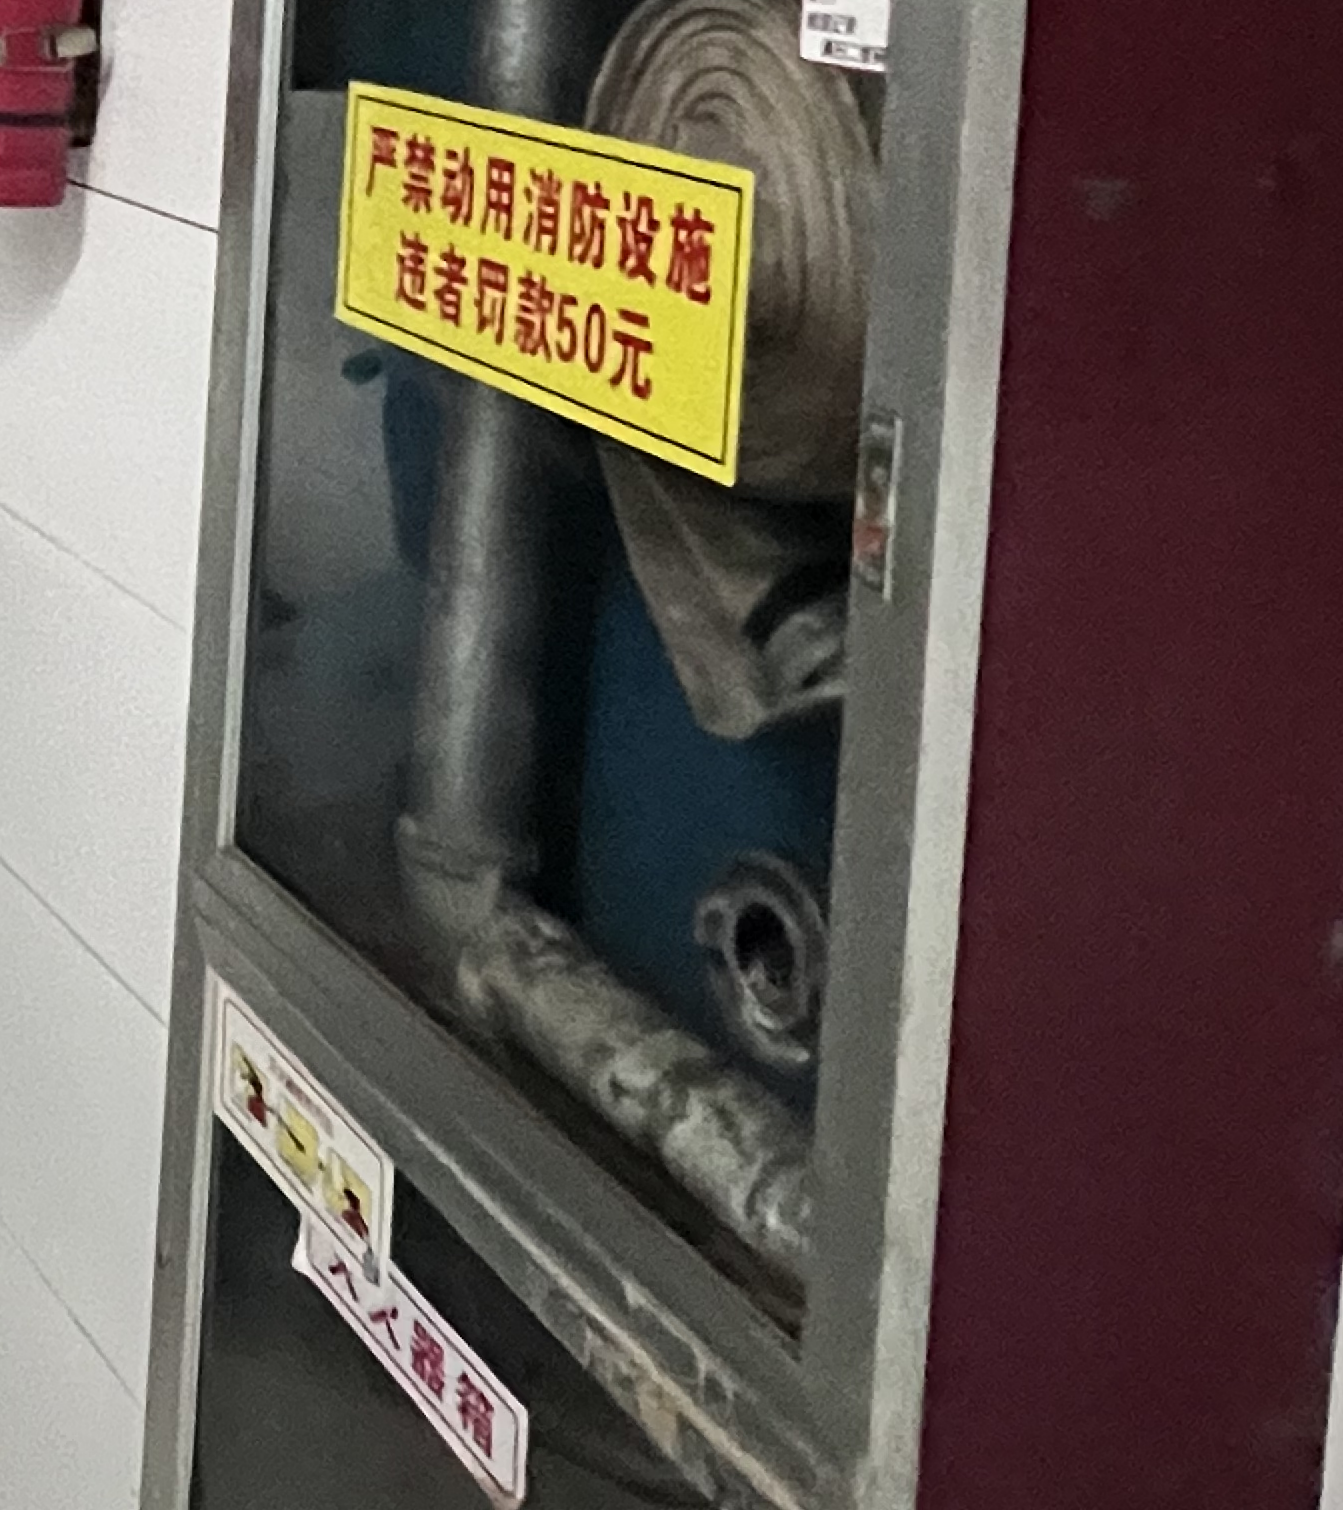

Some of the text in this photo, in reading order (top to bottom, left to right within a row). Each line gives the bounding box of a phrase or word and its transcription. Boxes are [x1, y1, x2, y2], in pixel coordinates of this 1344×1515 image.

[366, 126, 715, 305] 严禁动用消防设施
[396, 229, 654, 400] 违者罚款50元
